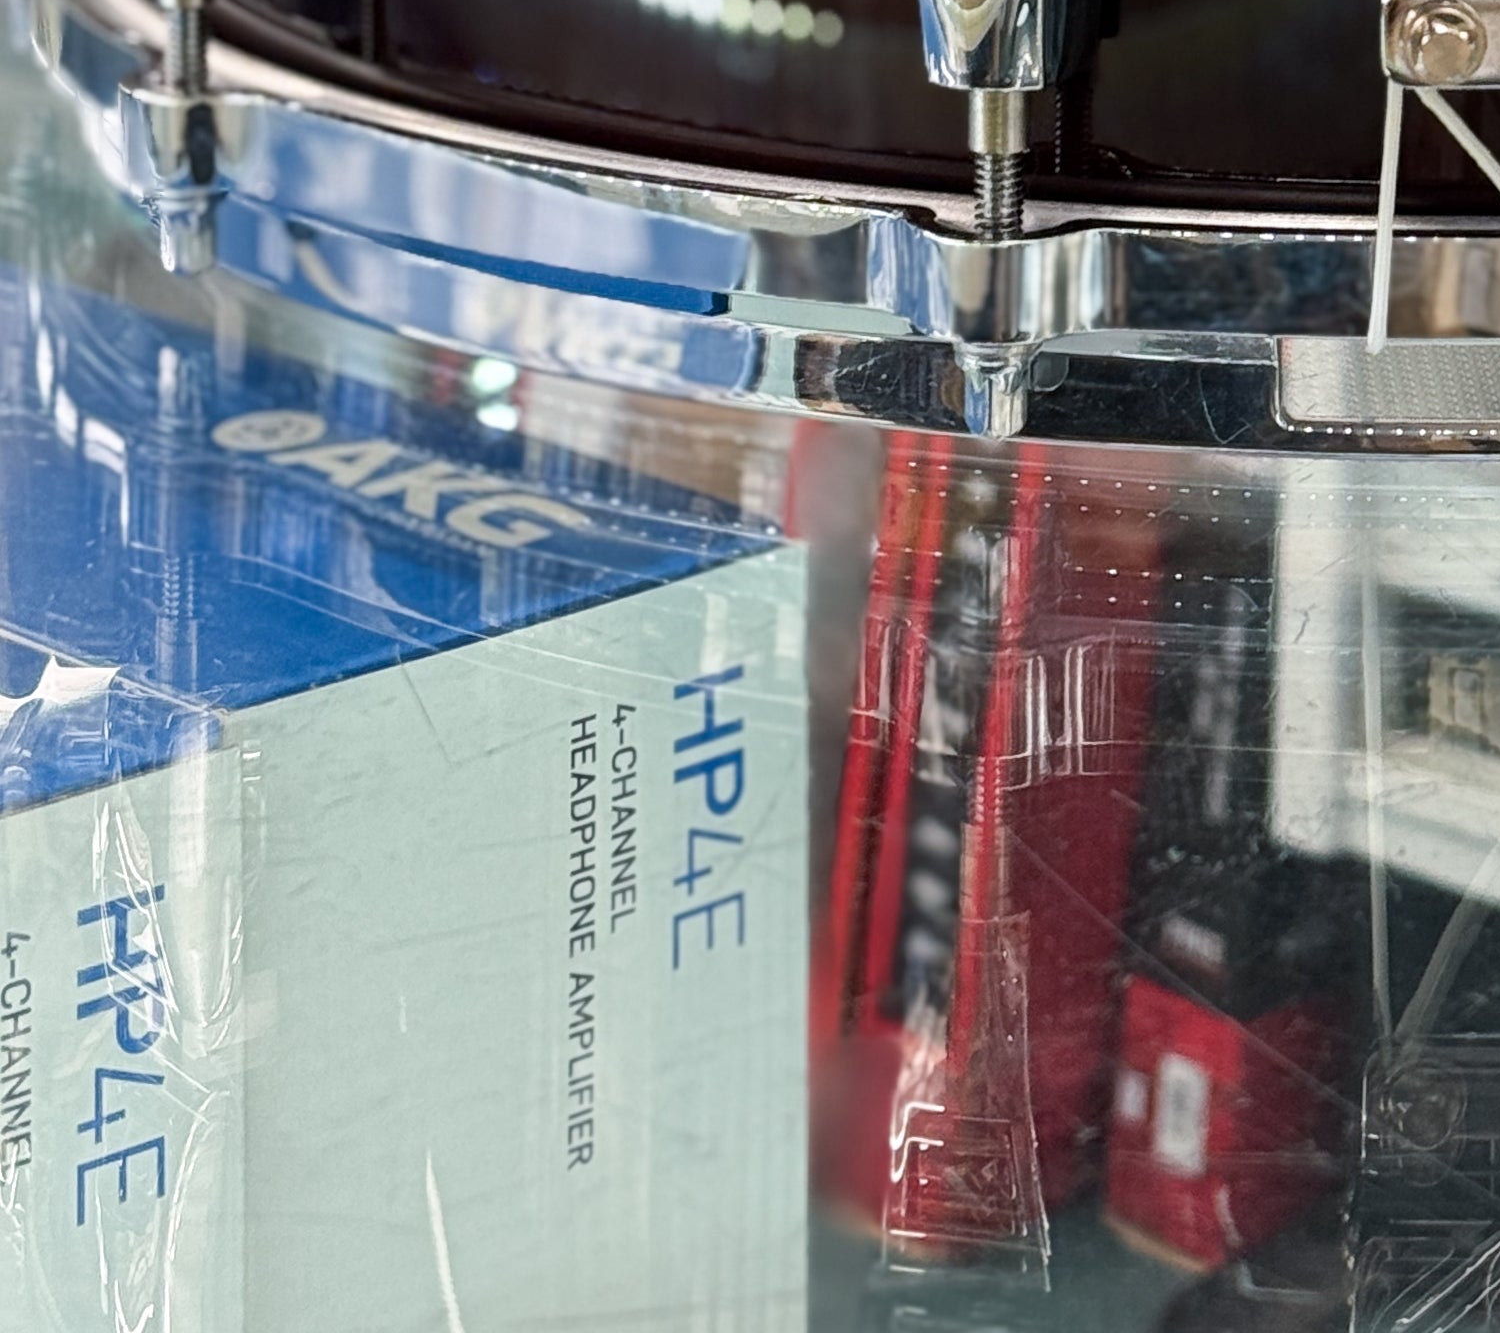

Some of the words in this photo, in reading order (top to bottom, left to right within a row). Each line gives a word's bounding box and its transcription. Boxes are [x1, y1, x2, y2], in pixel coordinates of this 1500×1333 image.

[267, 438, 592, 549] AKG
[569, 713, 598, 959] HEADPHONE
[610, 703, 638, 934] 4-CHANNEL
[674, 664, 745, 970] HP4E
[77, 882, 166, 1227] HP4E
[567, 972, 596, 1171] AMPLIFIER
